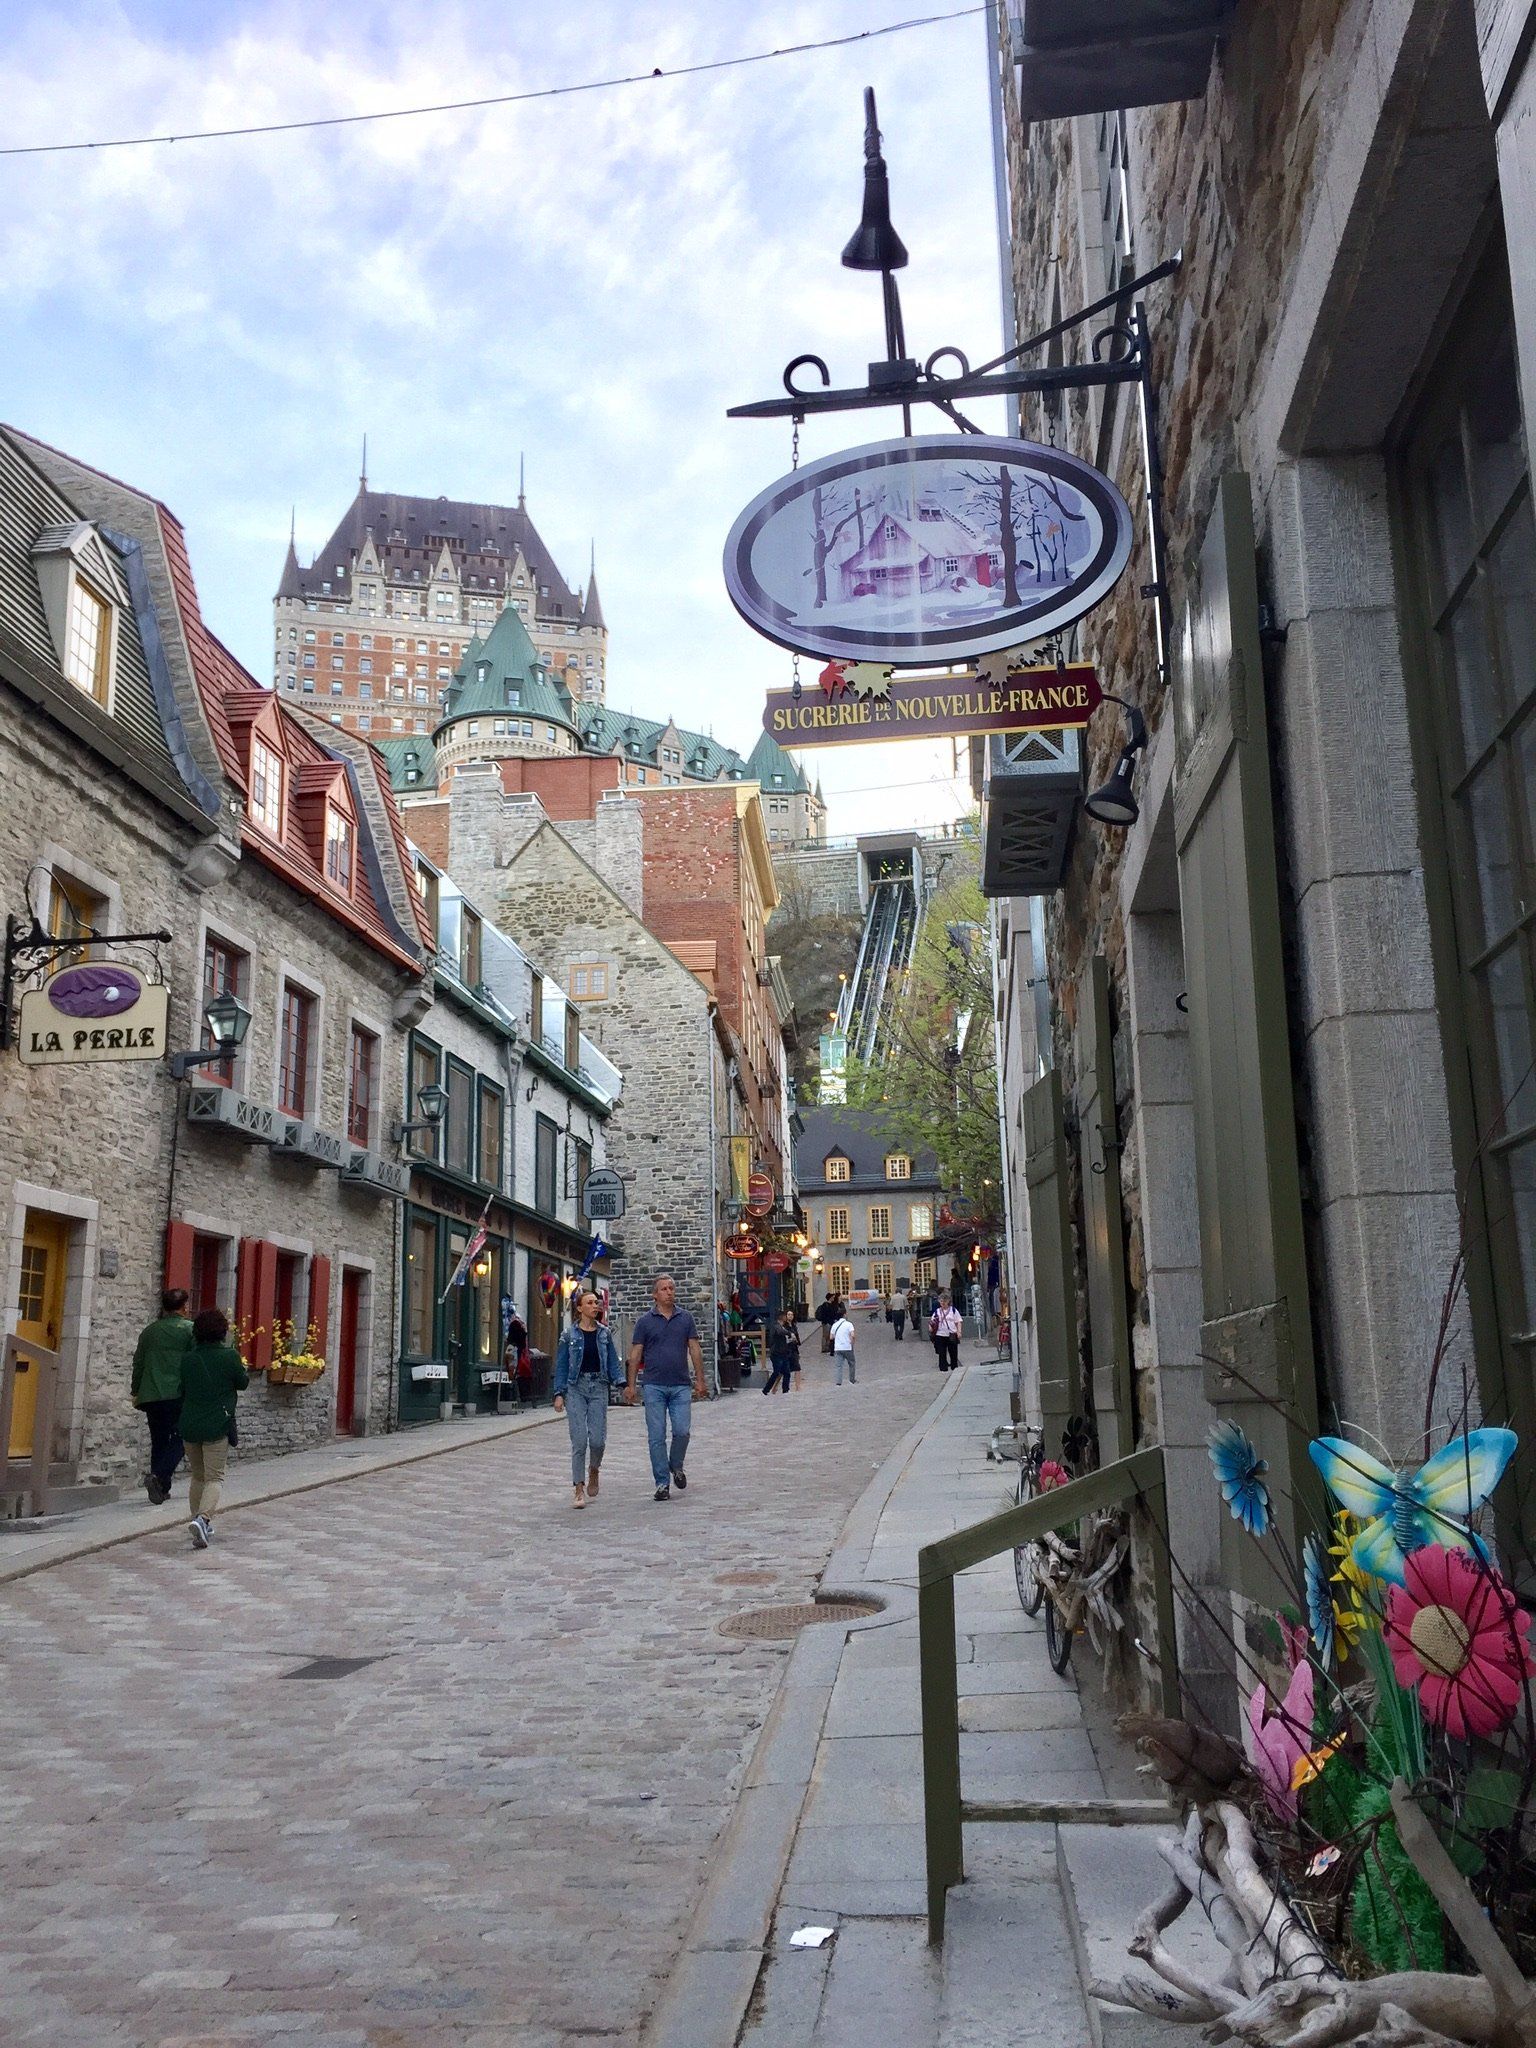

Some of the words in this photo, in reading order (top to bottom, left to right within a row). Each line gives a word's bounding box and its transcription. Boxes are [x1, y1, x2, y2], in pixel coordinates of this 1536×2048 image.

[875, 702, 892, 711] DE
[896, 684, 1090, 720] NOUVELLE-FRANCE
[773, 702, 872, 731] SUCRERIE
[875, 712, 892, 721] LA
[30, 1032, 63, 1052] LA
[73, 1027, 155, 1050] PERLE
[590, 1193, 616, 1205] QUÉBEC
[590, 1205, 616, 1216] URBAIN
[844, 1245, 918, 1257] FUNICULAIRE
